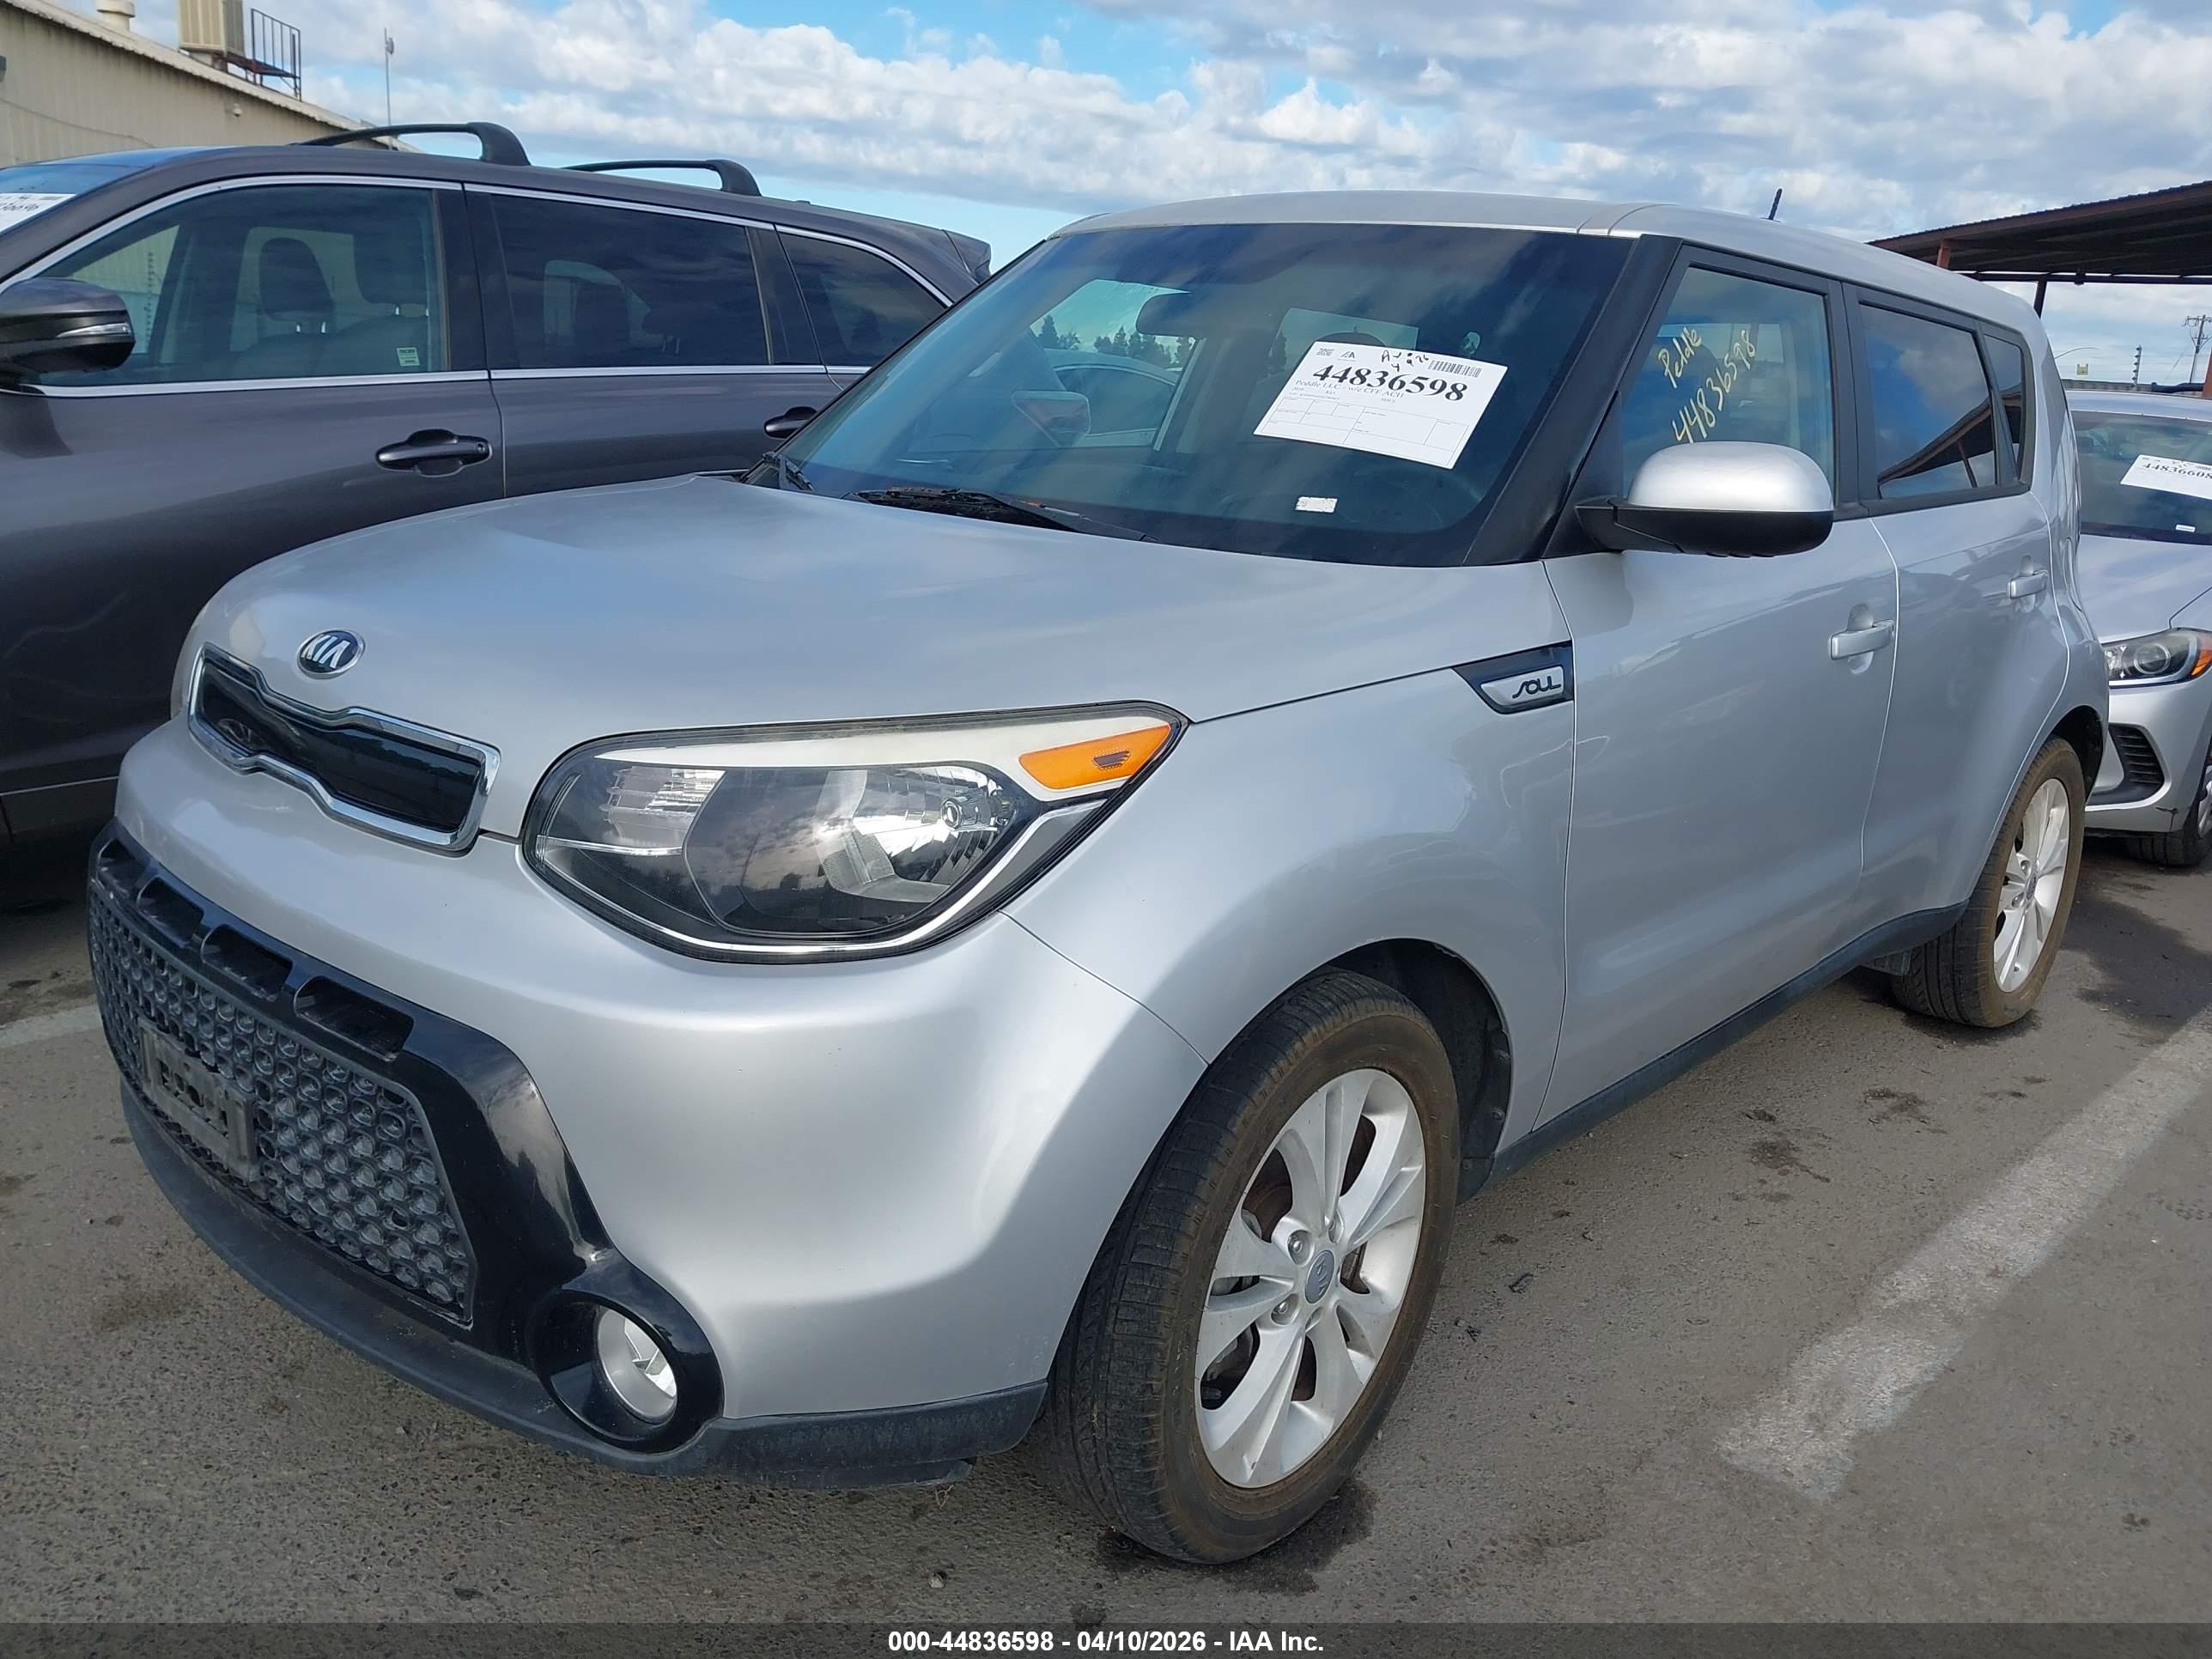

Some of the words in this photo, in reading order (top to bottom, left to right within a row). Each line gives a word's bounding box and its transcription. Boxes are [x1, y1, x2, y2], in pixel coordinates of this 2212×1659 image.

[1312, 364, 1468, 401] 44836598
[1322, 382, 1342, 391] LLC
[1672, 329, 1756, 444] 44836598
[2142, 463, 2212, 479] 44836608
[1512, 676, 1562, 699] SOUL
